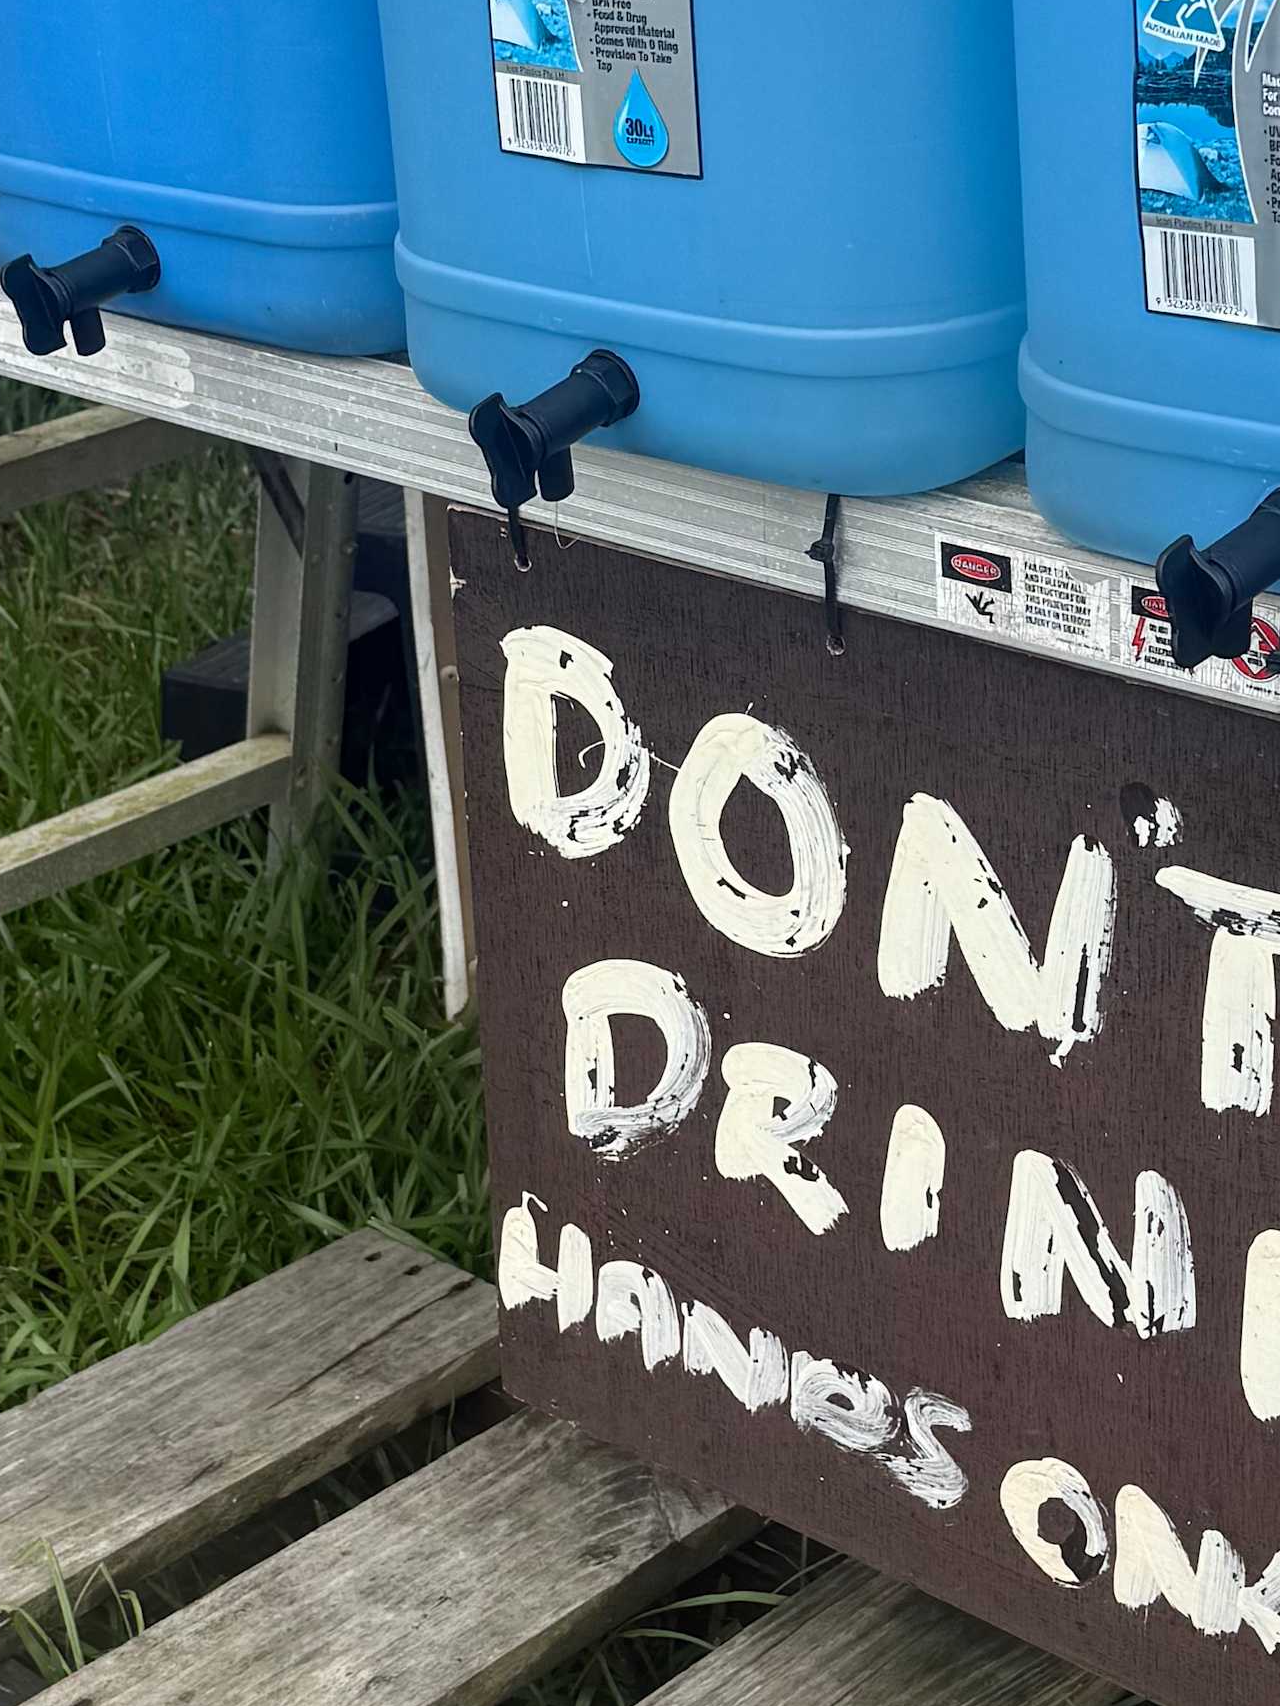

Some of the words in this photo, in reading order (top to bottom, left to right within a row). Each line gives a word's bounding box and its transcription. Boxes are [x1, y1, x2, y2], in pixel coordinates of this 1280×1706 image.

[593, 9, 614, 20] Food
[616, 11, 624, 21] &
[626, 12, 647, 26] Drug
[594, 22, 635, 35] Approved
[637, 25, 675, 38] Material
[1145, 21, 1193, 41] AUSTRALIAN
[1196, 34, 1221, 47] MADE
[595, 34, 624, 47] Comes
[626, 37, 646, 49] With
[658, 40, 679, 54] Ring
[595, 47, 636, 61] Provision
[638, 51, 648, 62] To
[650, 52, 672, 64] Take
[596, 60, 612, 73] Tap
[1262, 88, 1278, 102] For
[625, 117, 654, 138] 30Lt
[954, 558, 997, 576] DANGER
[1025, 594, 1040, 604] THIS
[1076, 605, 1091, 616] MAY
[496, 1191, 972, 1510] HANDS
